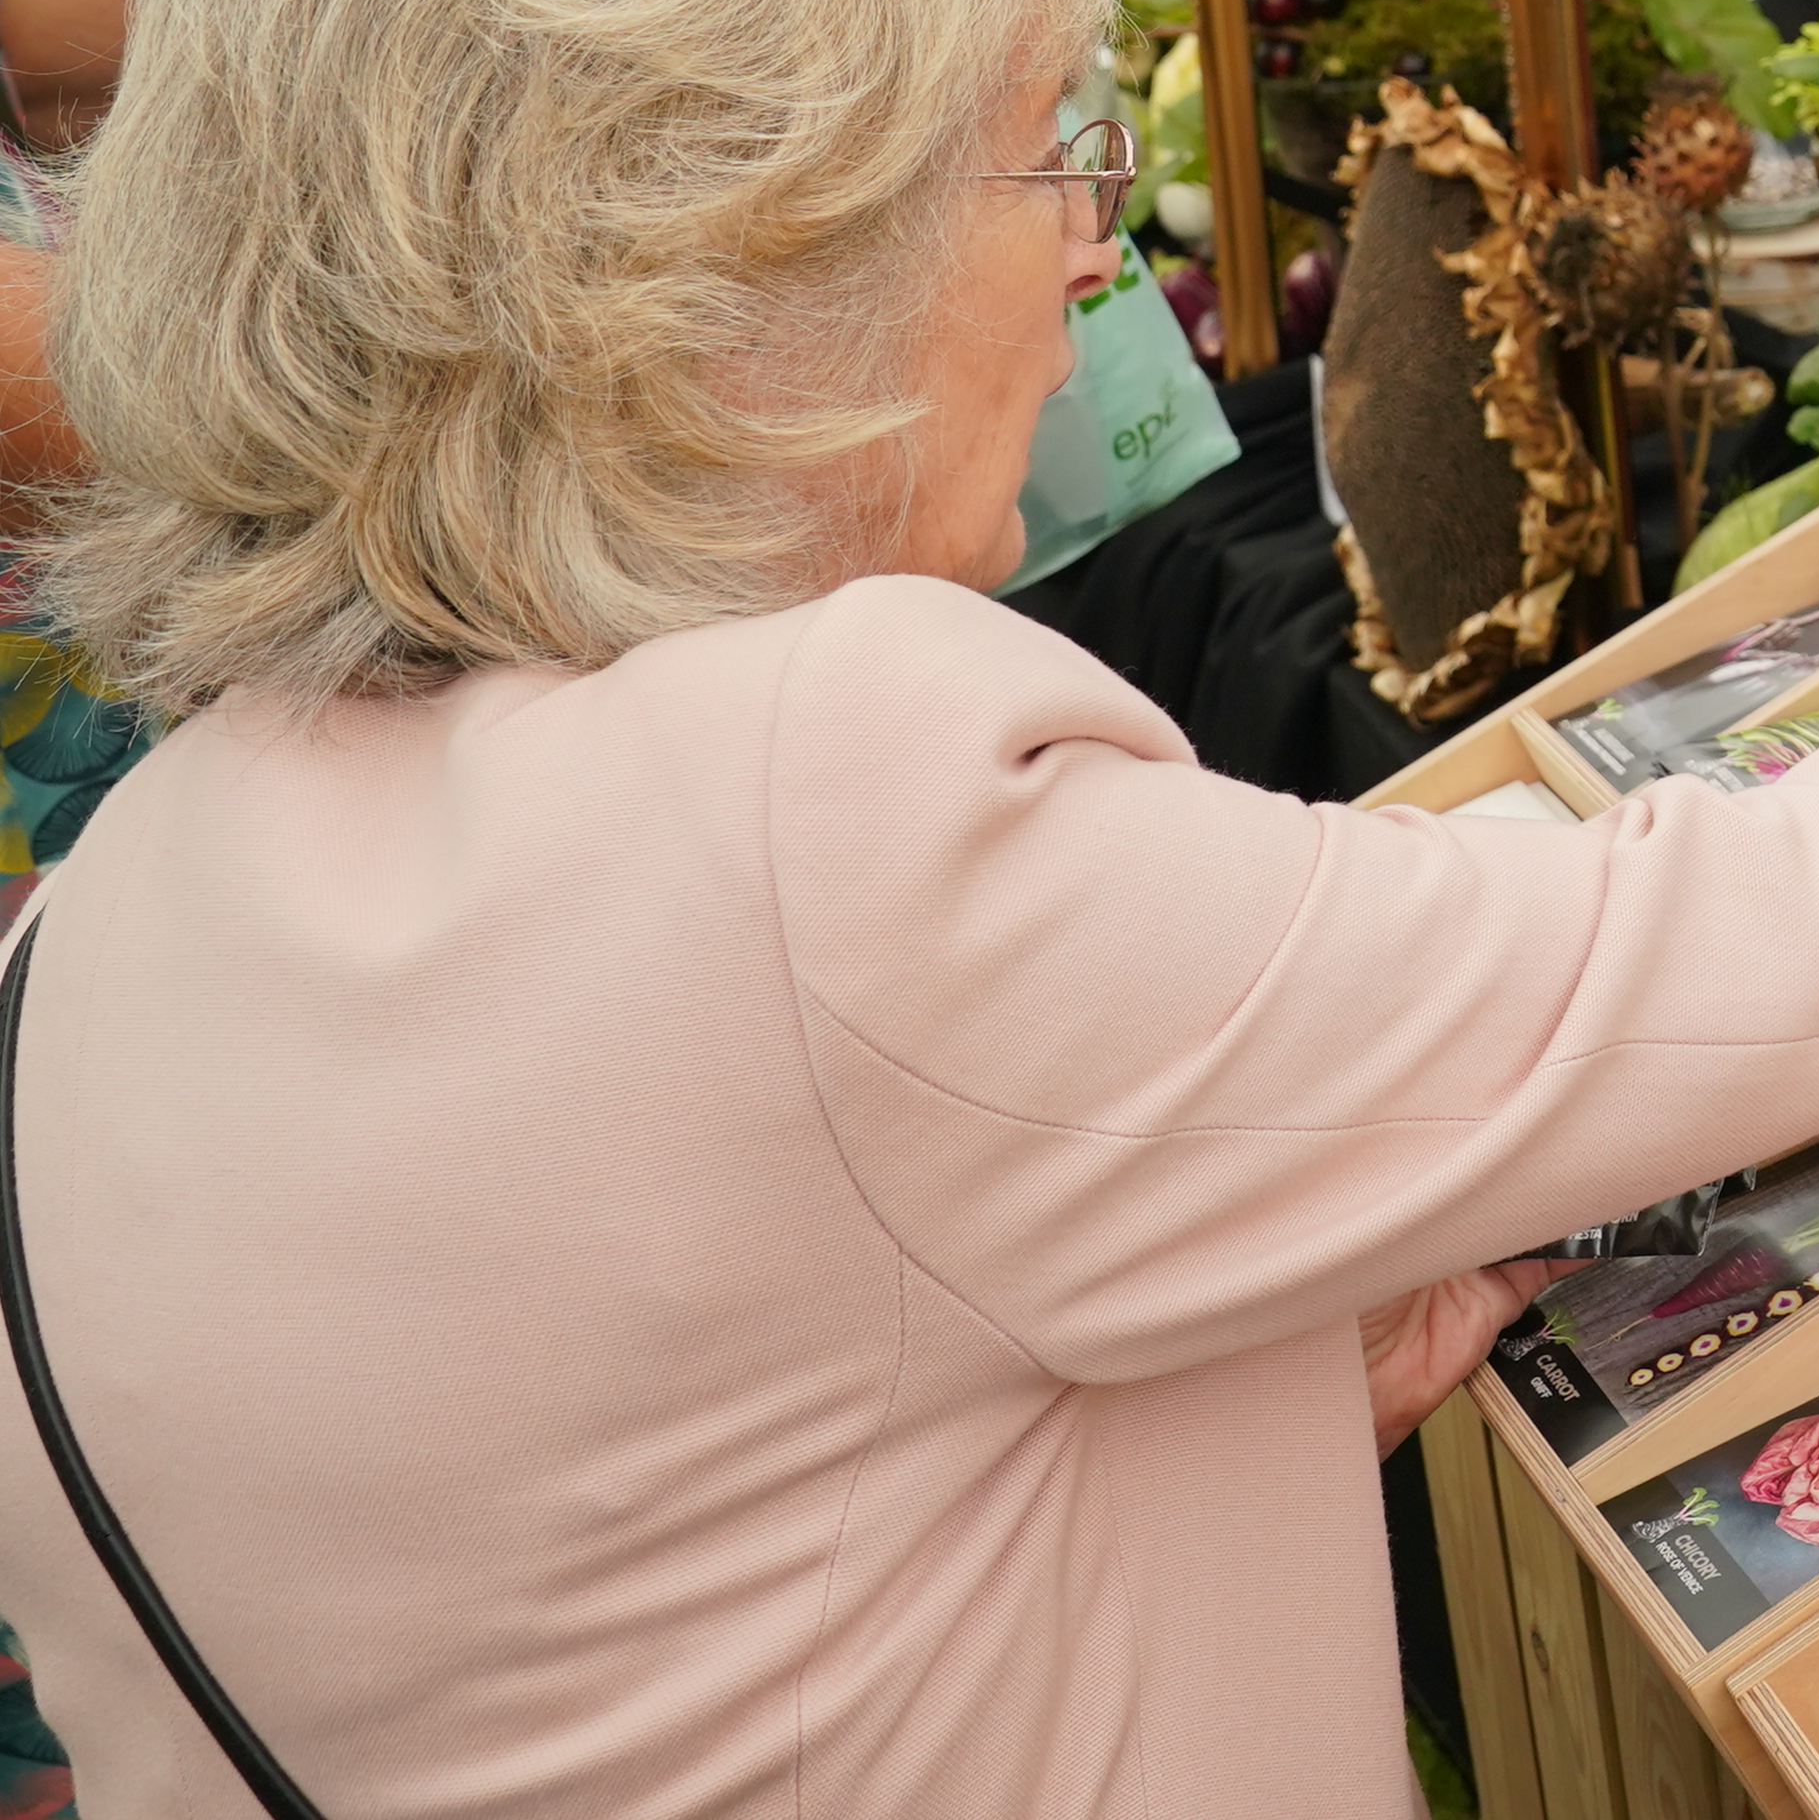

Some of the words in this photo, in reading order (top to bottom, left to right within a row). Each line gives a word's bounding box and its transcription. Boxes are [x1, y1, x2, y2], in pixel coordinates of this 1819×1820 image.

[1536, 1354, 1581, 1401] CARROT
[1655, 1541, 1678, 1563] ROSE
[1670, 1558, 1685, 1570] OF
[1674, 1534, 1721, 1580] CHICORY
[1677, 1567, 1704, 1595] VENICE
